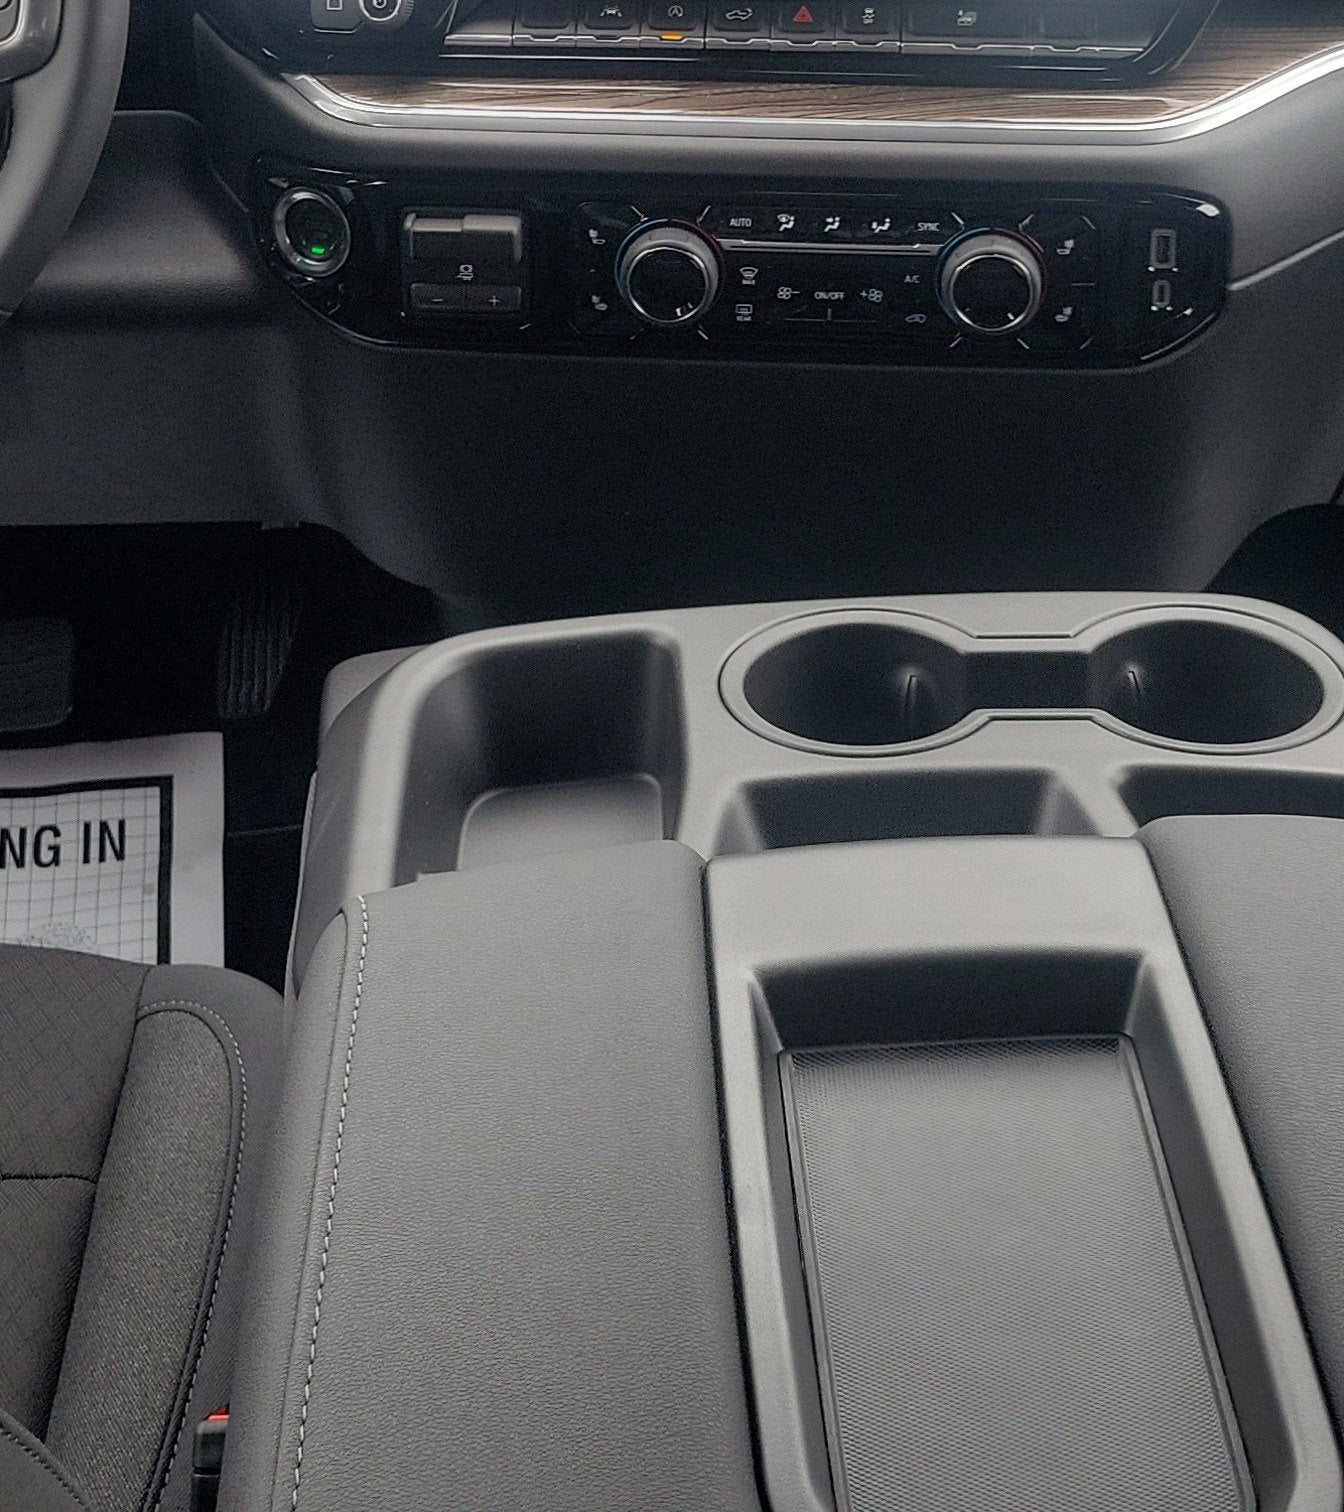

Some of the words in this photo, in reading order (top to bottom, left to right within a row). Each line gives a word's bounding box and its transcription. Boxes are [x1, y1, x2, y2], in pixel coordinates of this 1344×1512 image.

[729, 218, 752, 227] AUTO
[917, 222, 941, 232] SYNC
[904, 275, 920, 284] A/C
[814, 290, 846, 300] ON/OFF
[82, 819, 127, 865] IN
